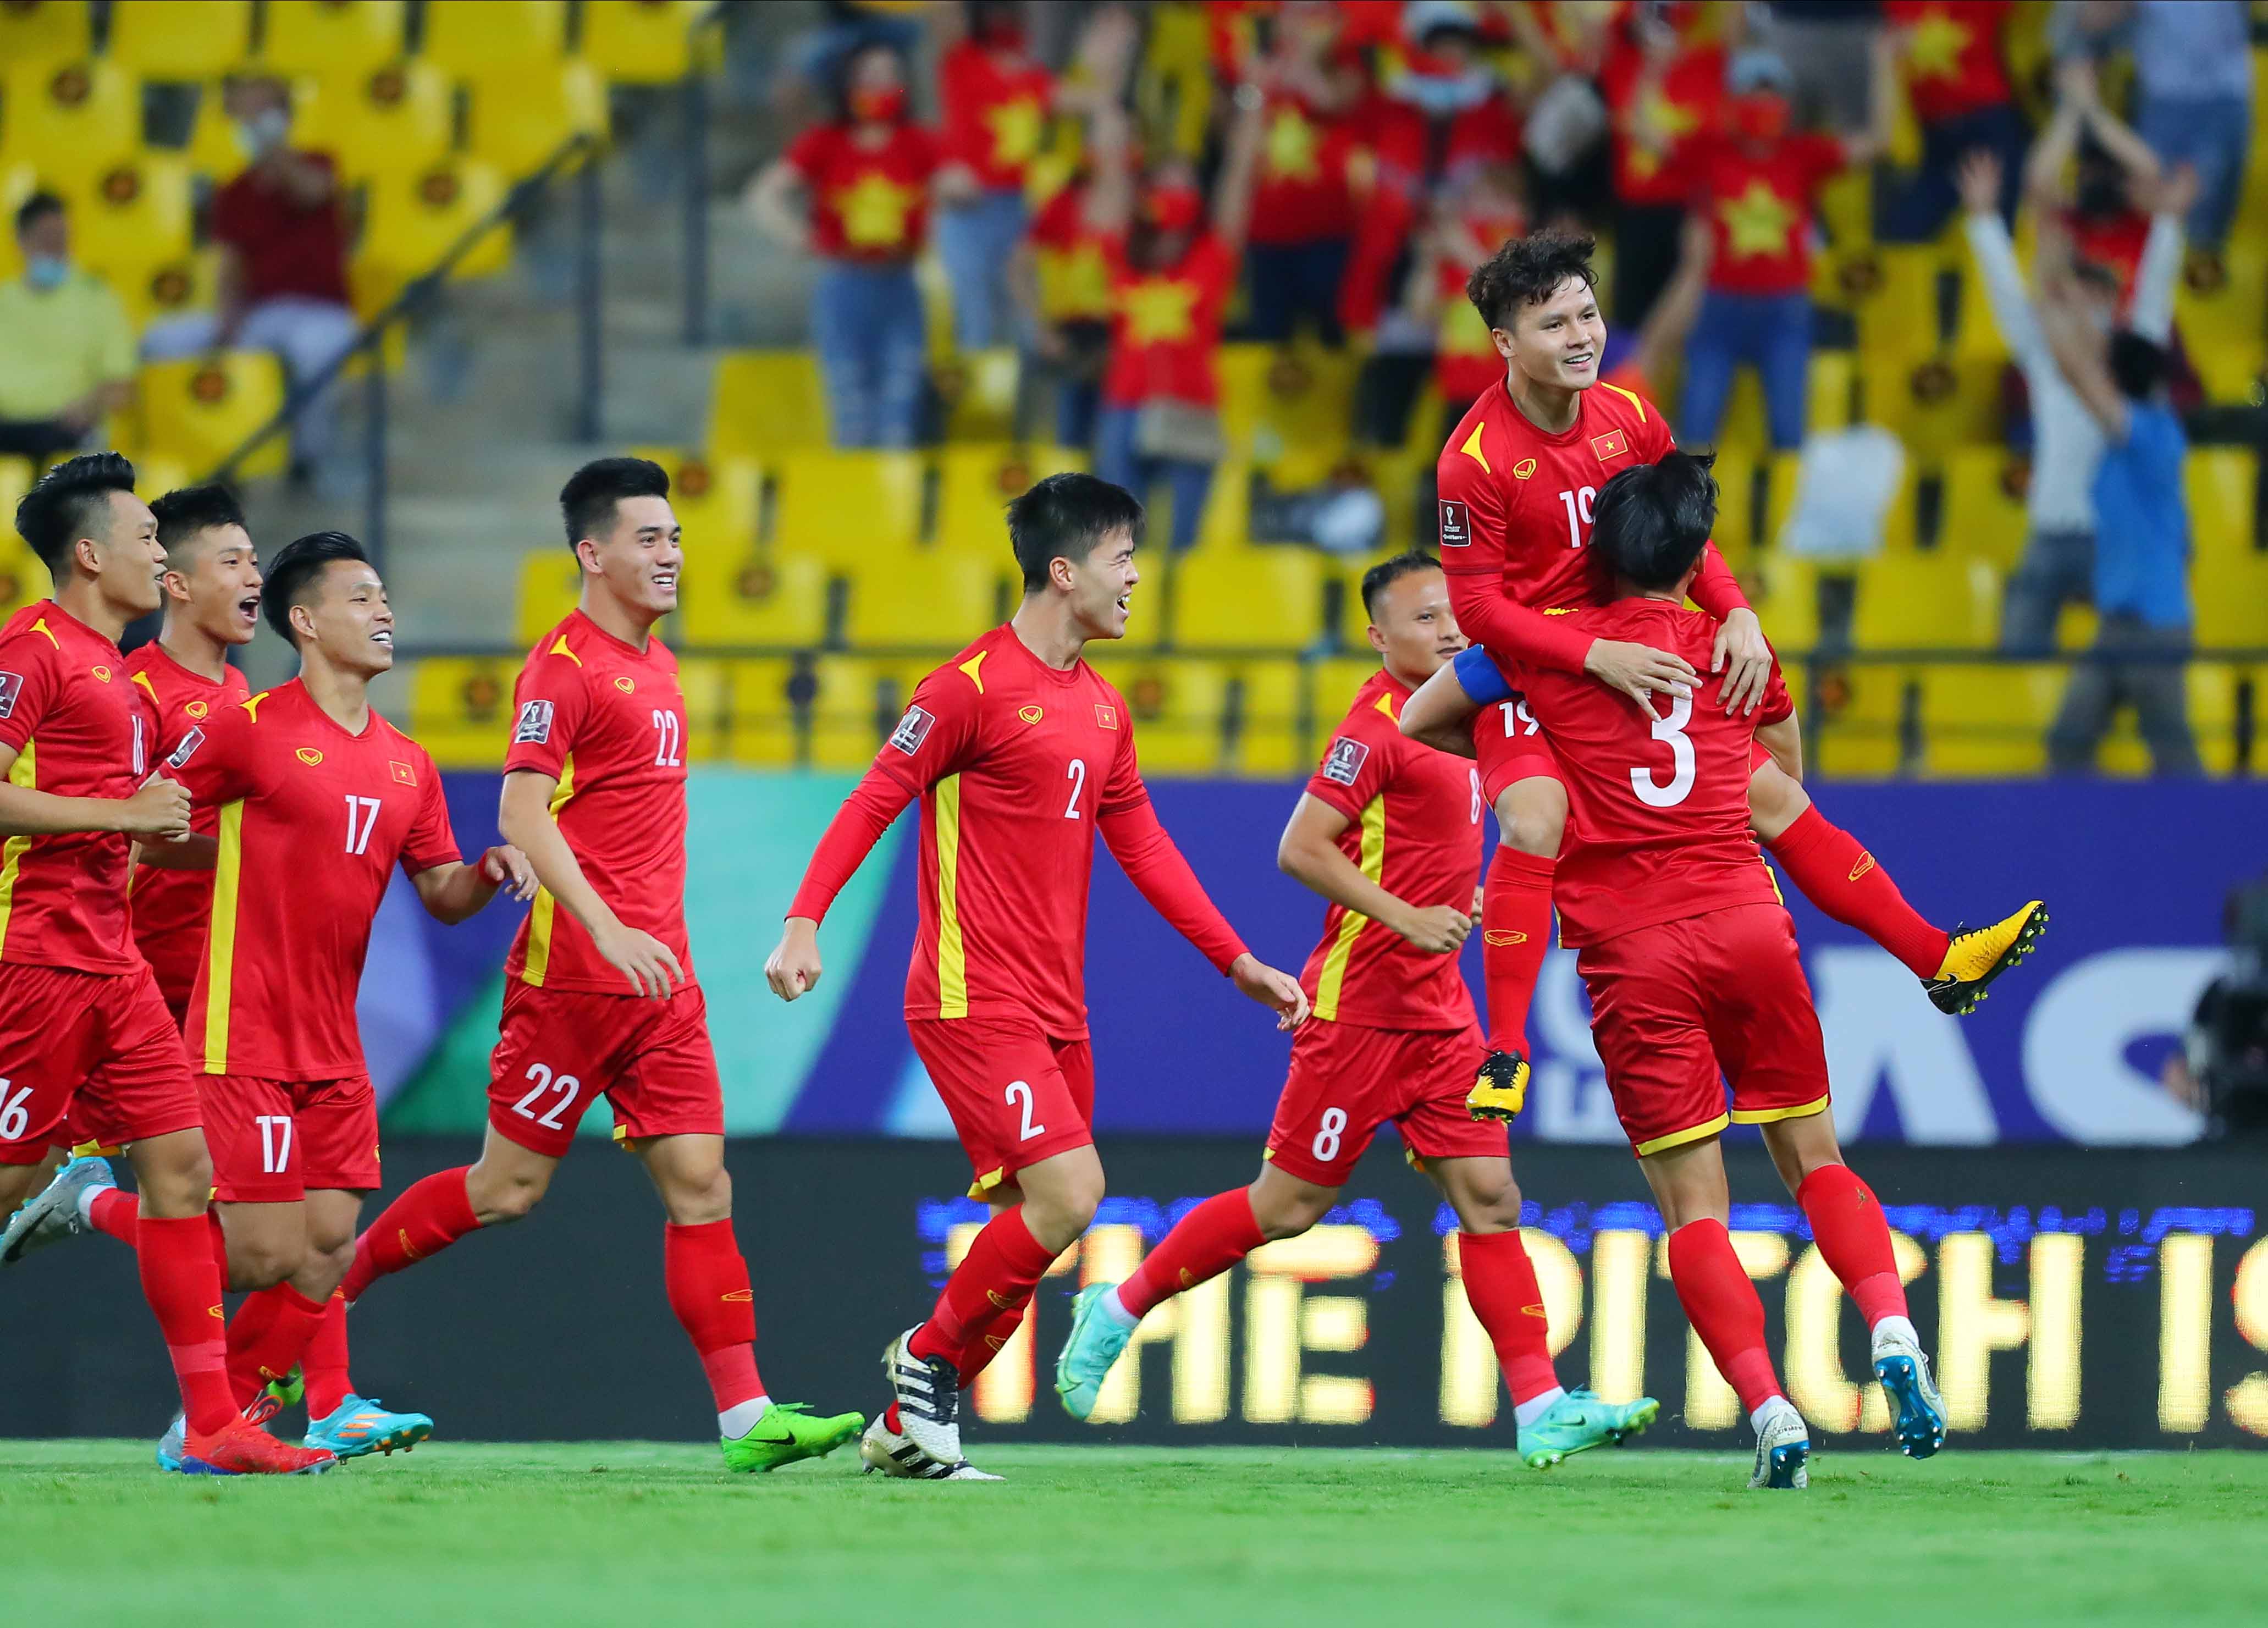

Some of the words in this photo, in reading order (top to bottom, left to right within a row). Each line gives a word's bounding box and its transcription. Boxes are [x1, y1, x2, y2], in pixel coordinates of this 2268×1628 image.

[653, 709, 681, 767] 22
[1499, 700, 1539, 738] 19
[1630, 678, 1696, 807] 3
[1064, 759, 1086, 819] 2
[1469, 768, 1481, 825] 8
[345, 794, 382, 856] 17
[511, 1063, 580, 1130] 22
[1005, 1081, 1046, 1142] 2
[256, 1115, 292, 1173] 17
[1312, 1107, 1347, 1162] 8
[946, 1224, 1379, 1425] THE
[1439, 1228, 2085, 1435] PITCH
